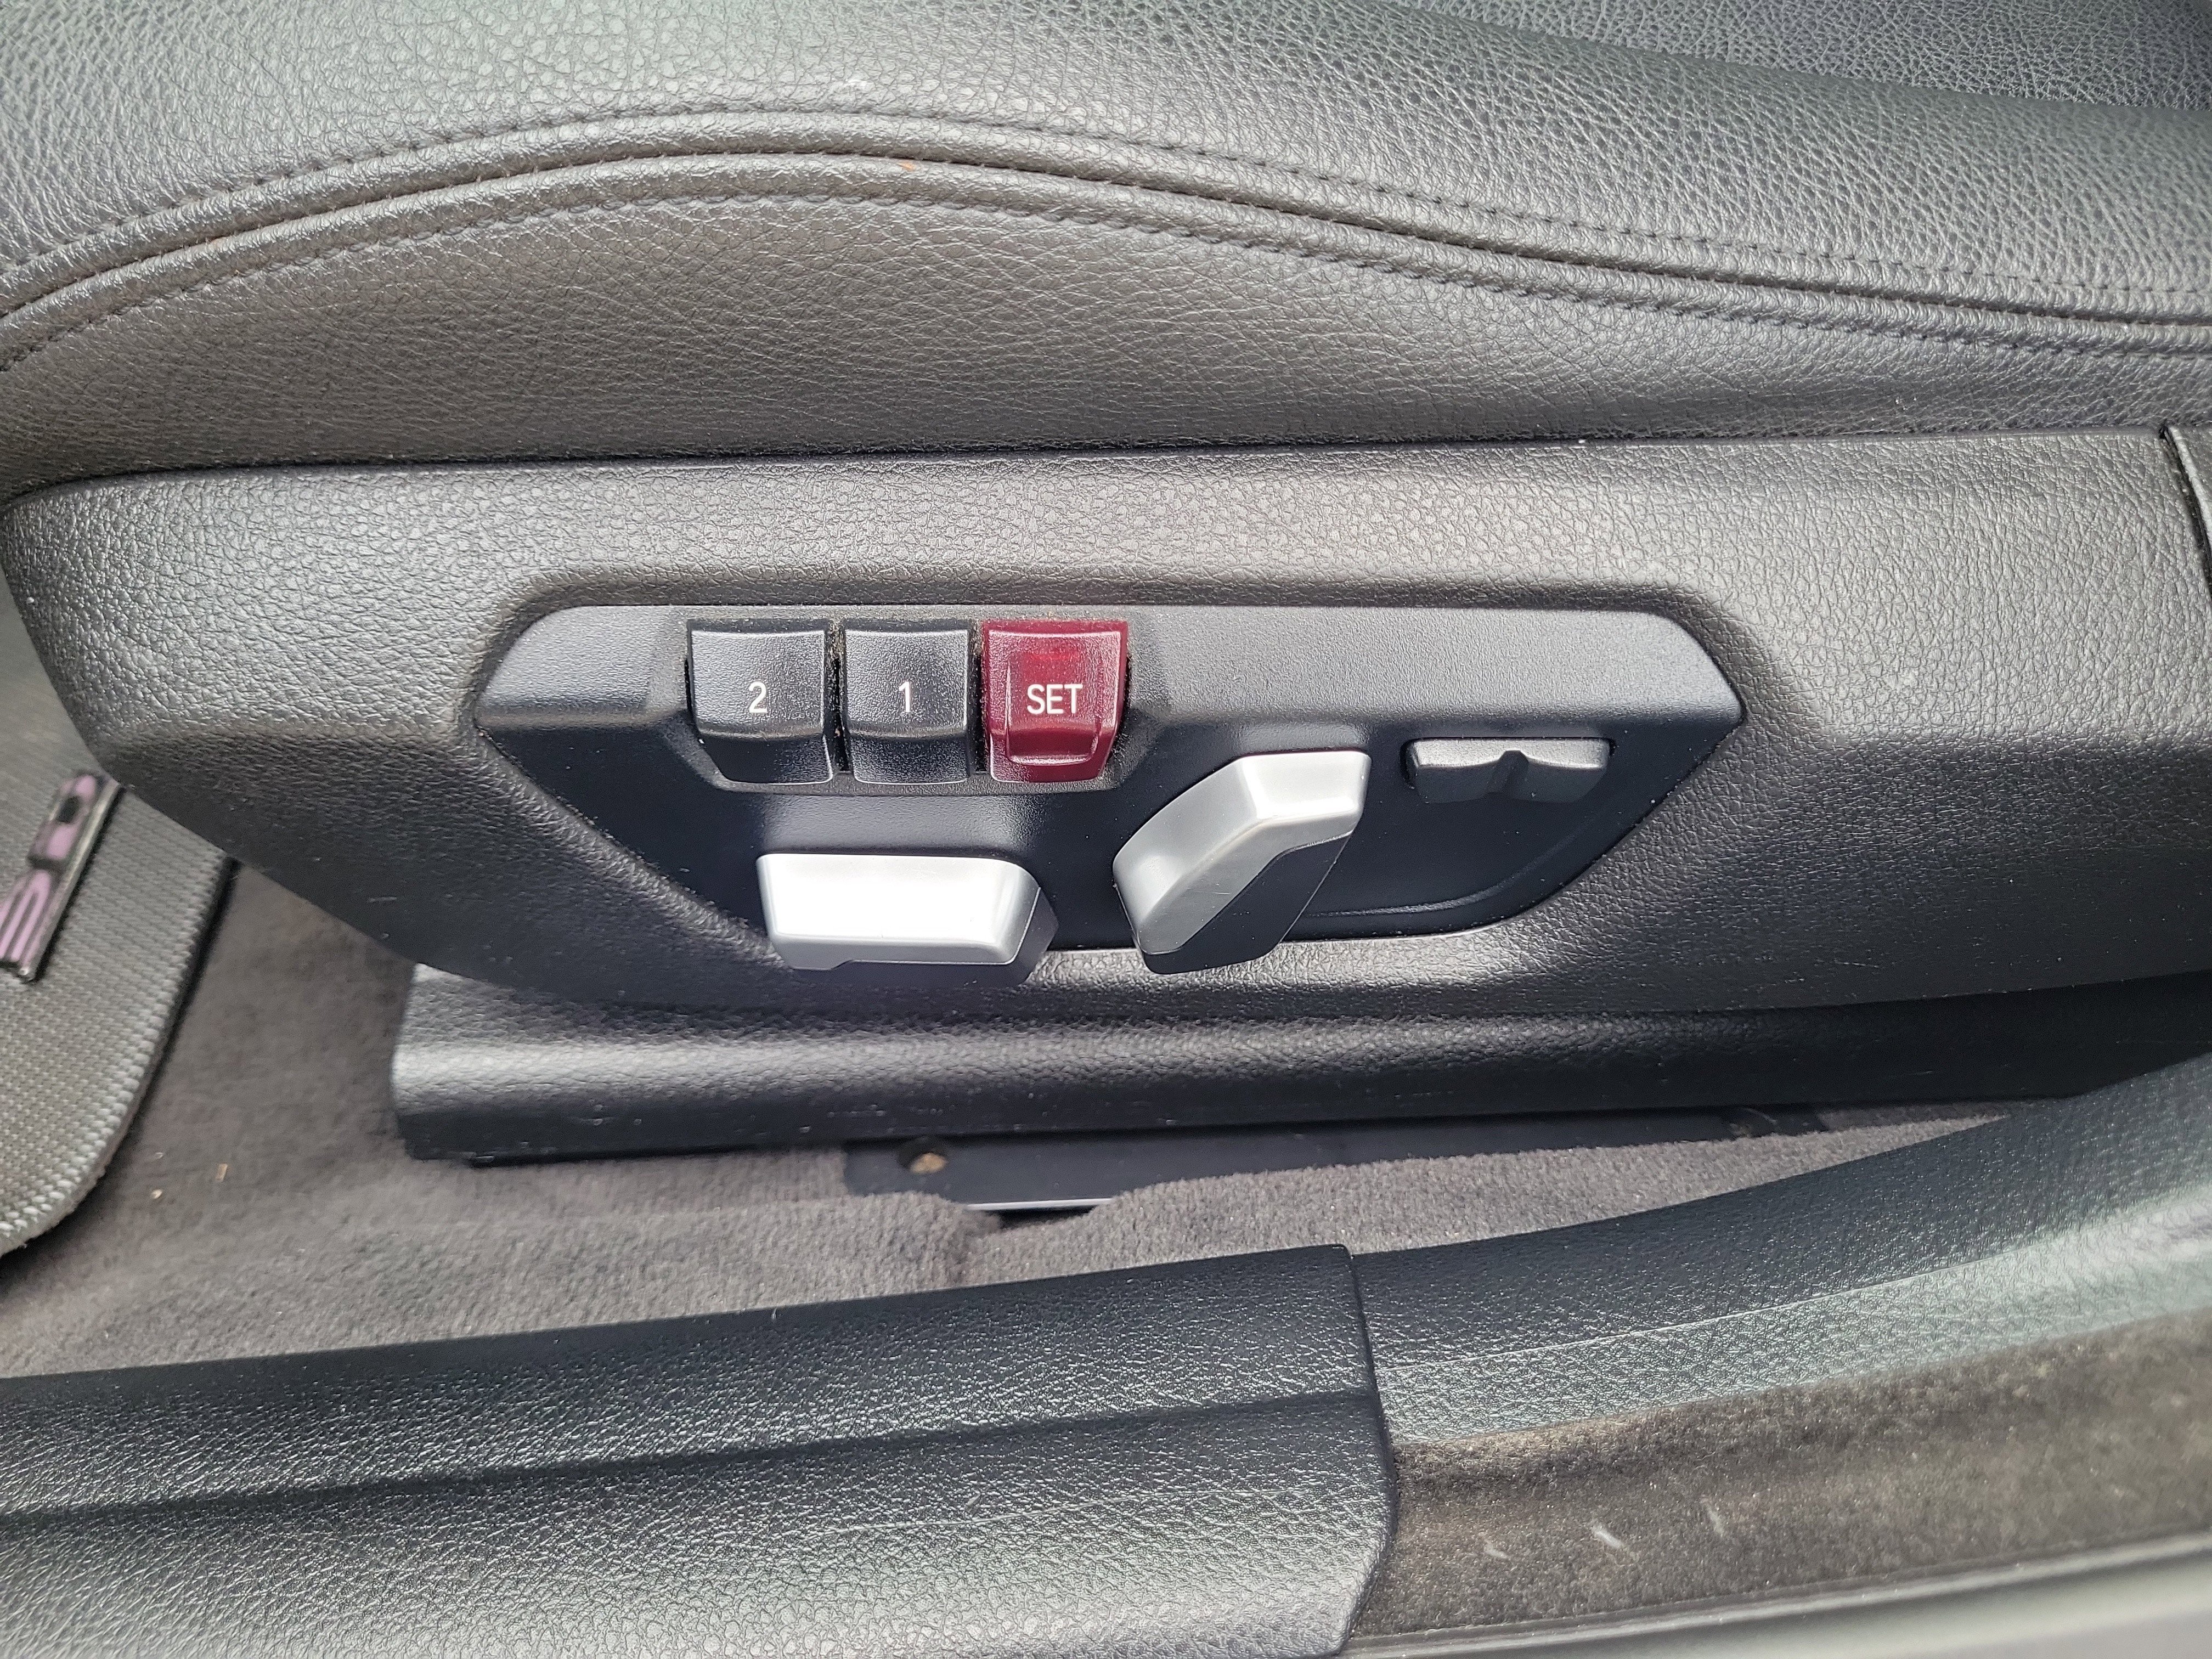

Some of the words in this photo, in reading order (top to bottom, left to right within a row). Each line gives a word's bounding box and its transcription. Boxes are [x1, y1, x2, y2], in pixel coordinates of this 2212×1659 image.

[747, 681, 768, 714] 2
[898, 681, 911, 713] 1
[1026, 683, 1083, 714] SET
